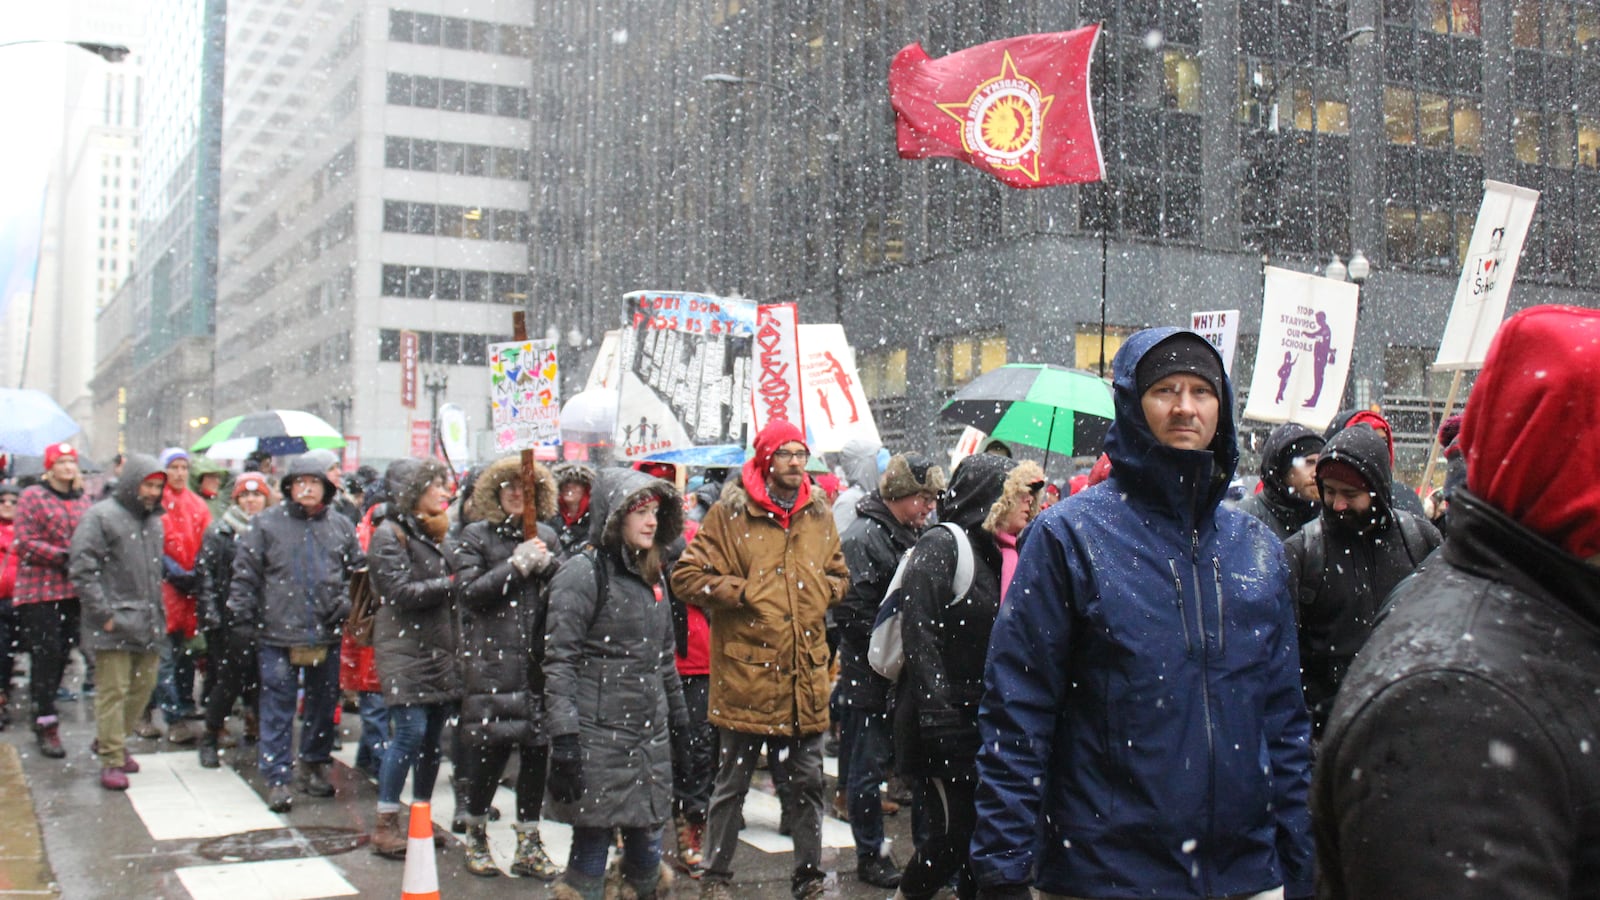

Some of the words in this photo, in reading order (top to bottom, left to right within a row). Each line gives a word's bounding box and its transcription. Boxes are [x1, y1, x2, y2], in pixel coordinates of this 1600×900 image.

[639, 295, 681, 310] LORI
[1296, 305, 1314, 317] STOP
[632, 312, 678, 331] PASS
[686, 317, 703, 332] US
[710, 319, 734, 334] BY
[1194, 314, 1214, 329] WHY
[1217, 313, 1226, 328] IS
[1280, 314, 1317, 330] STARVING
[1286, 327, 1302, 338] OUR
[1281, 337, 1313, 352] SCHOOLS
[499, 347, 552, 372] FIGHT
[625, 445, 647, 456] CPS
[650, 440, 671, 451] KIDS
